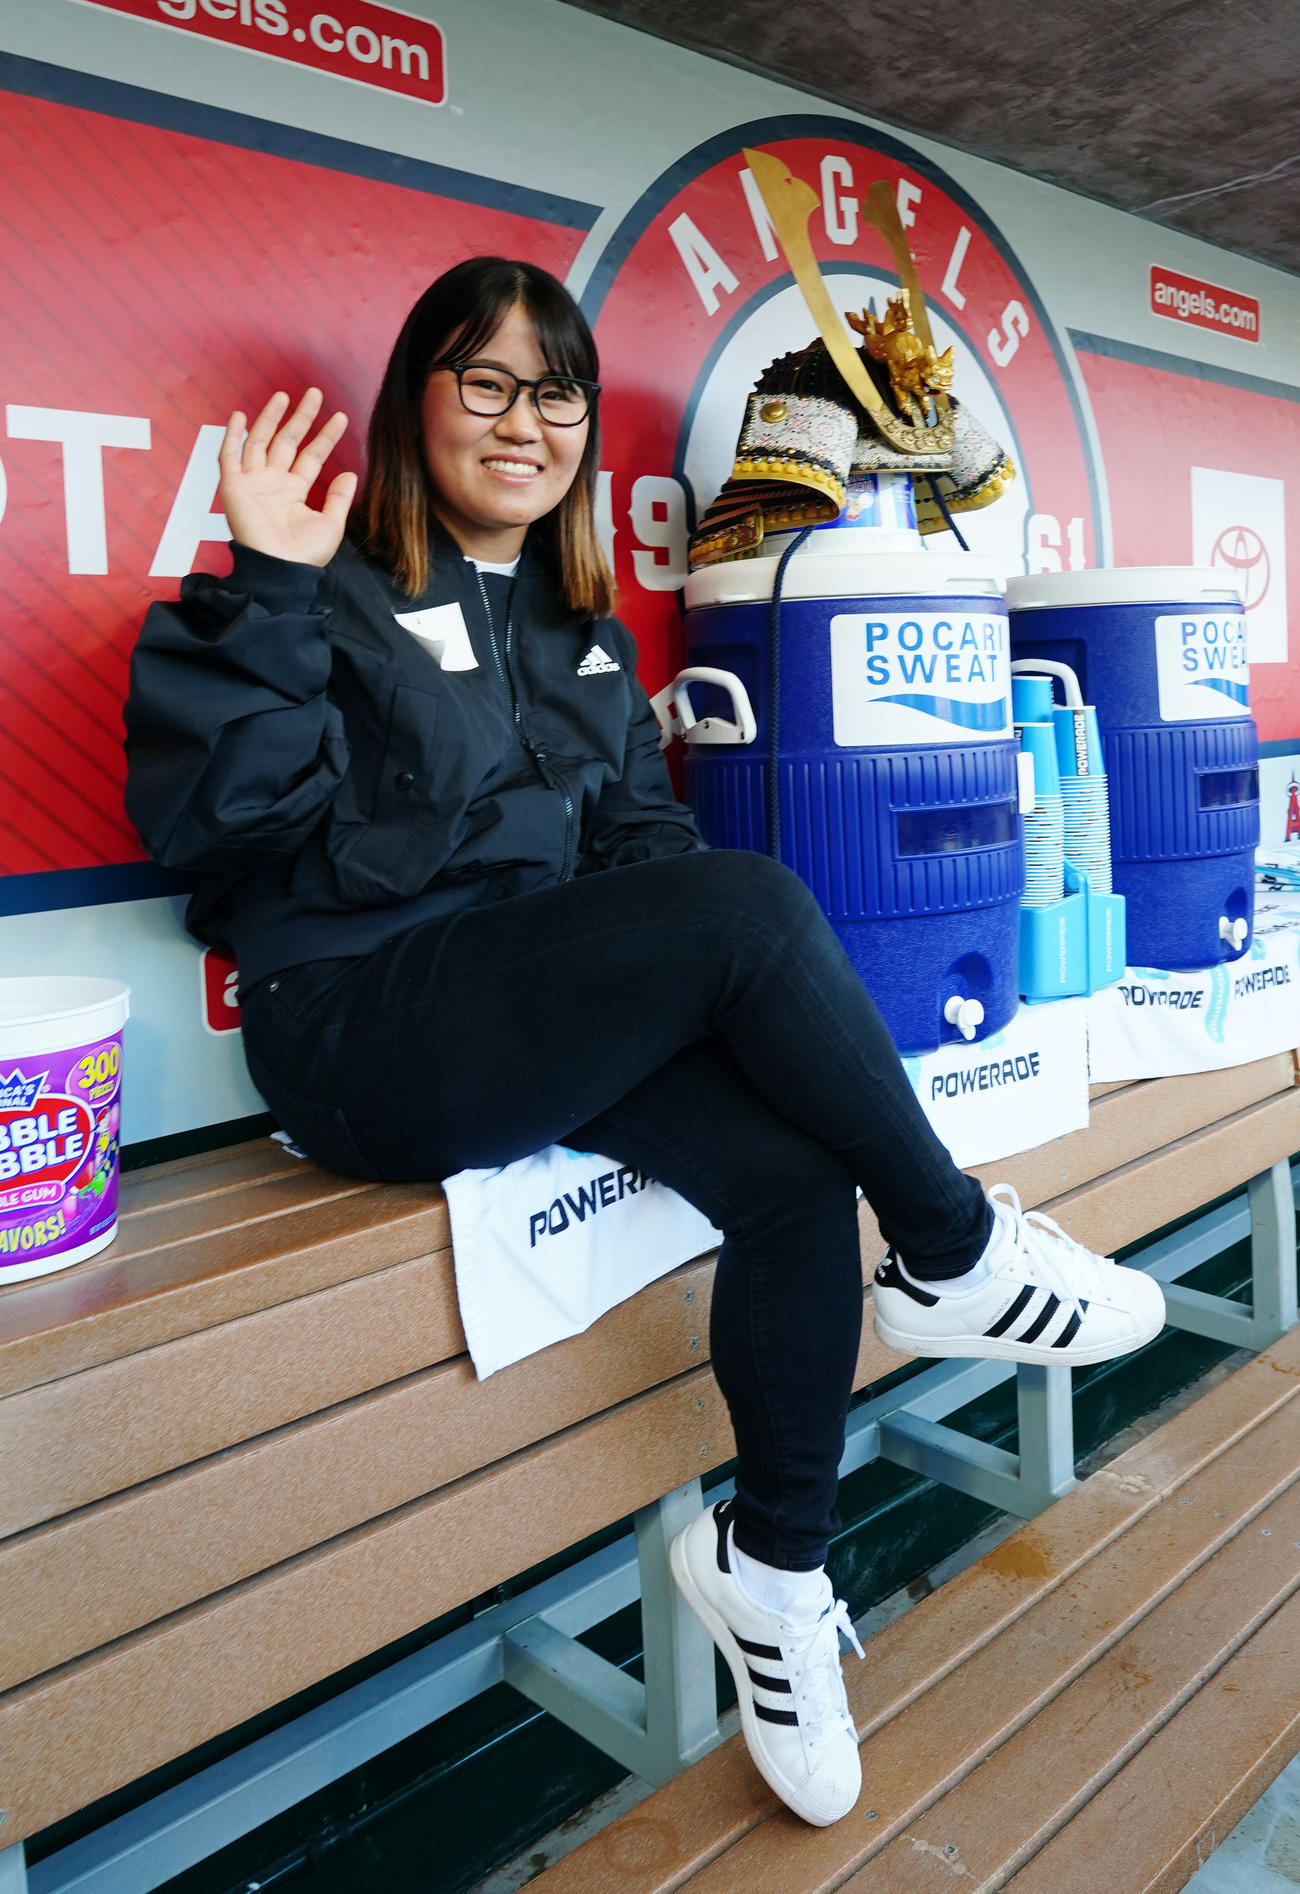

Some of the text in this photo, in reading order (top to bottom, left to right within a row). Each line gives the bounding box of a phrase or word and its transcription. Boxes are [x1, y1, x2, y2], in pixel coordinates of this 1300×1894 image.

[1154, 282, 1257, 331] angels.com
[0, 403, 248, 578] TA
[1026, 513, 1086, 575] 61
[865, 621, 1004, 652] POCARI
[577, 661, 621, 677] adidas
[866, 654, 998, 686] SWEAT
[78, 1045, 120, 1089] 300
[931, 1051, 1040, 1101] POWERADE
[21, 1184, 56, 1203] GUM
